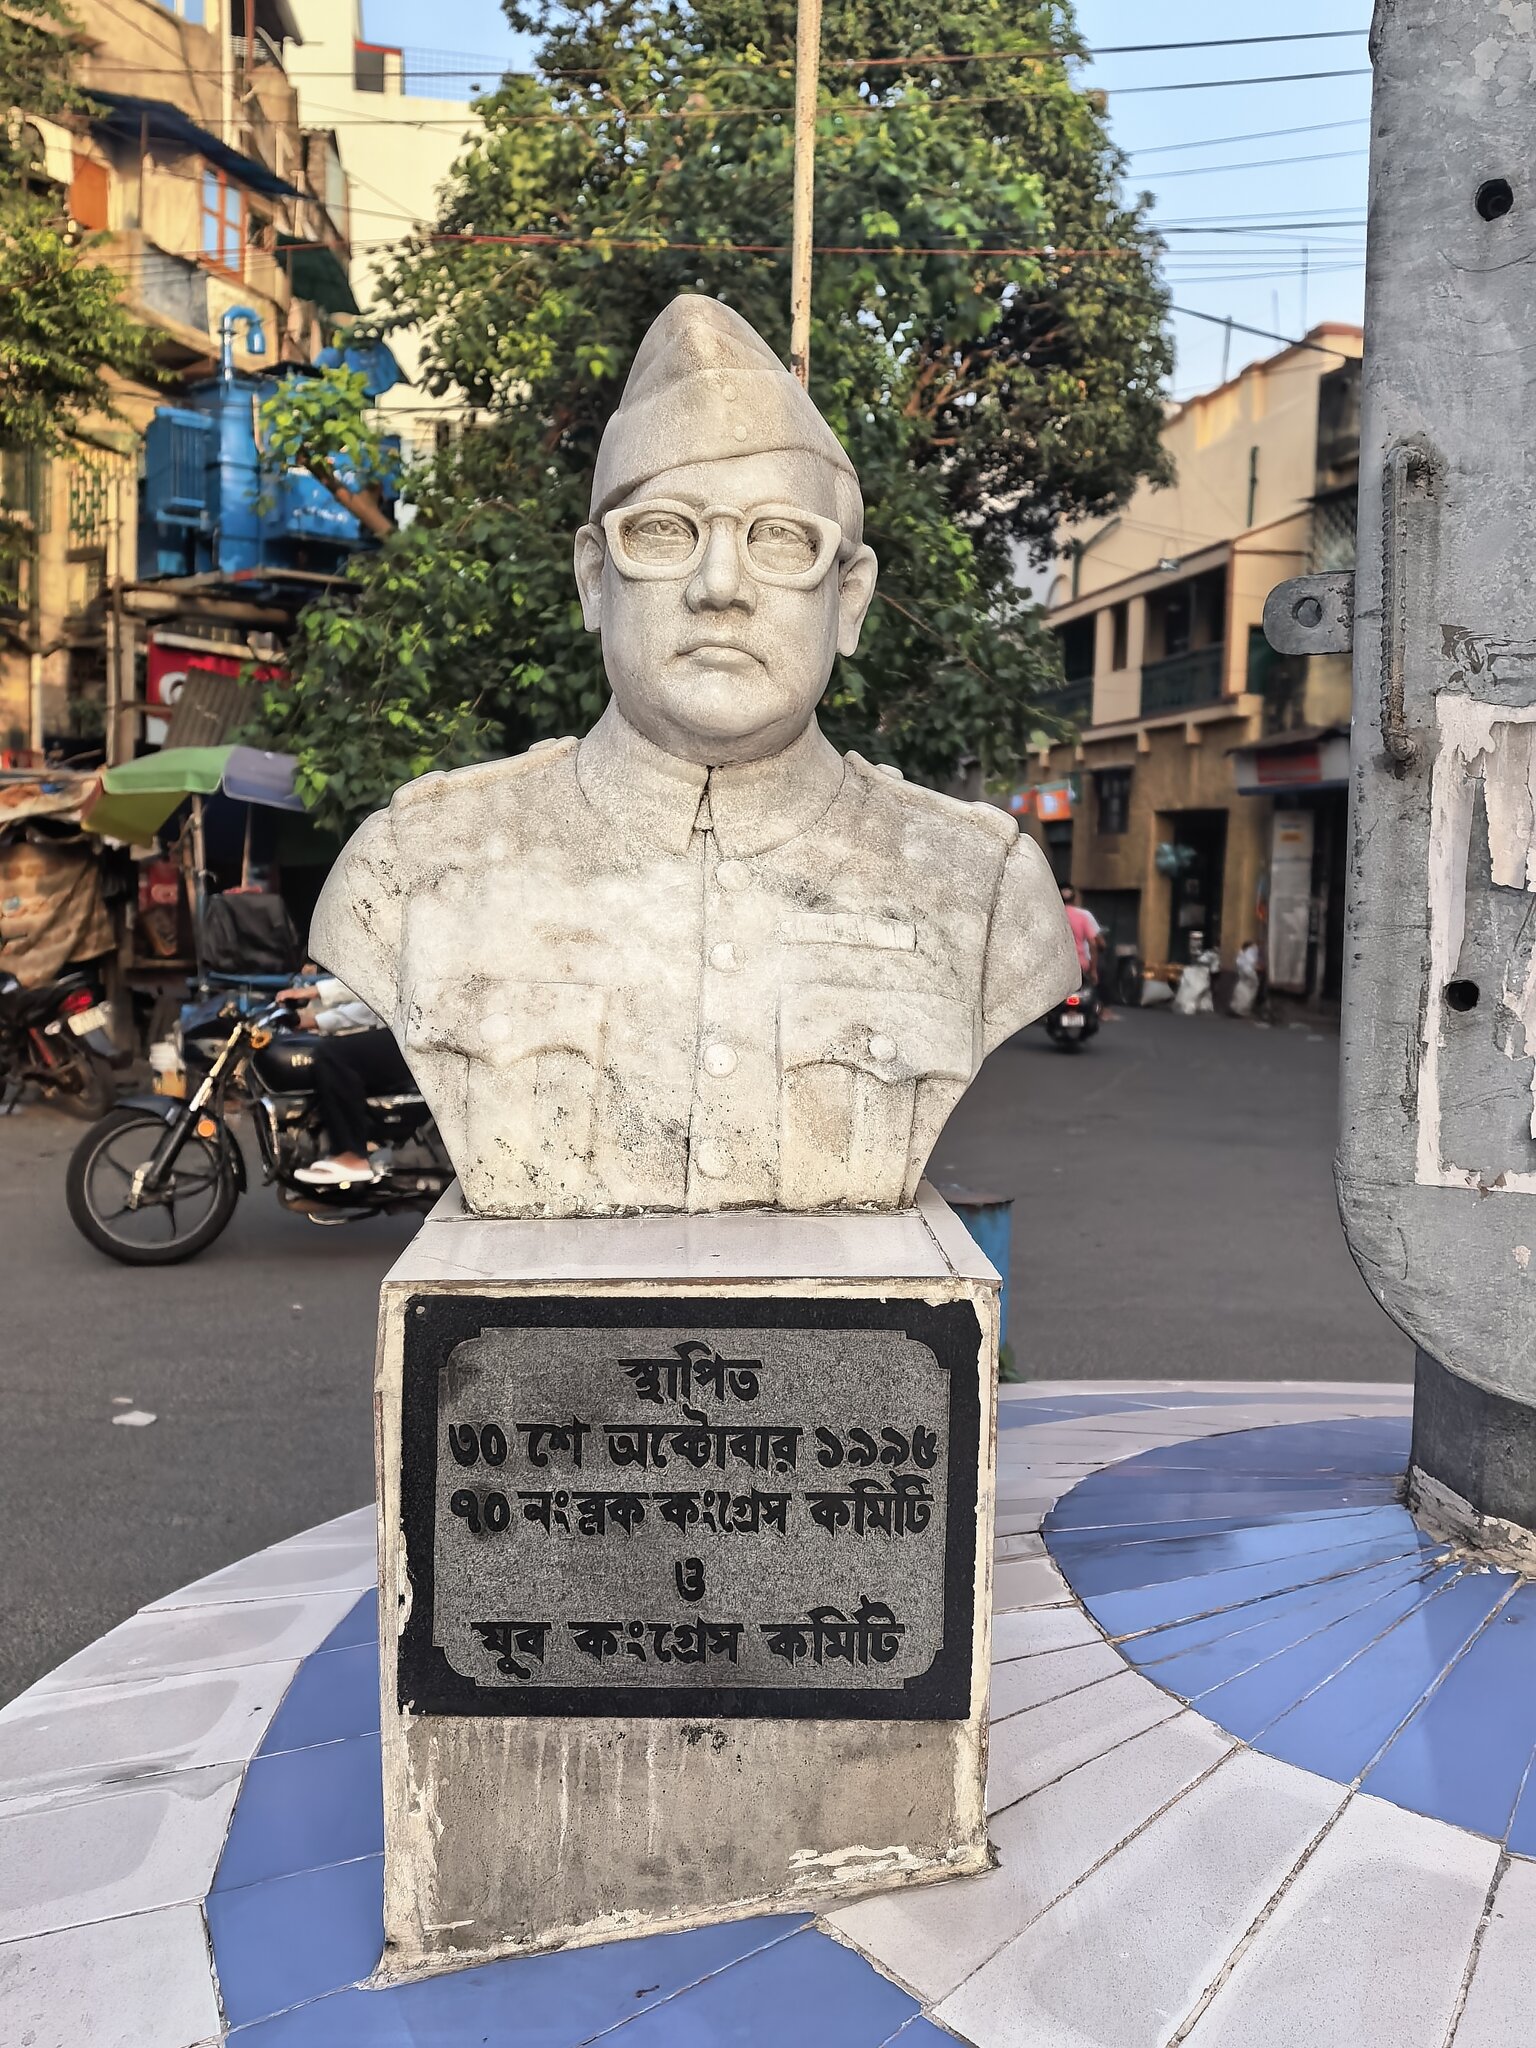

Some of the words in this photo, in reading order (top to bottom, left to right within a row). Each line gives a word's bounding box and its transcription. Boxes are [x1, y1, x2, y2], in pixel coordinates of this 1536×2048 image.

[618, 1341, 762, 1404] স্থাপিত
[449, 1423, 508, 1467] ৩০
[516, 1415, 591, 1469] শে
[604, 1404, 803, 1472] অক্টোবার
[815, 1425, 938, 1469] ১৯৯৫
[450, 1489, 510, 1533] ৭০
[652, 1487, 792, 1535] কংগ্রেস
[804, 1471, 934, 1537] কমিটি
[675, 1557, 706, 1601] ও
[470, 1622, 552, 1680] যুব
[568, 1616, 744, 1665] কংগ্রেস
[760, 1594, 905, 1666] কমিটি
